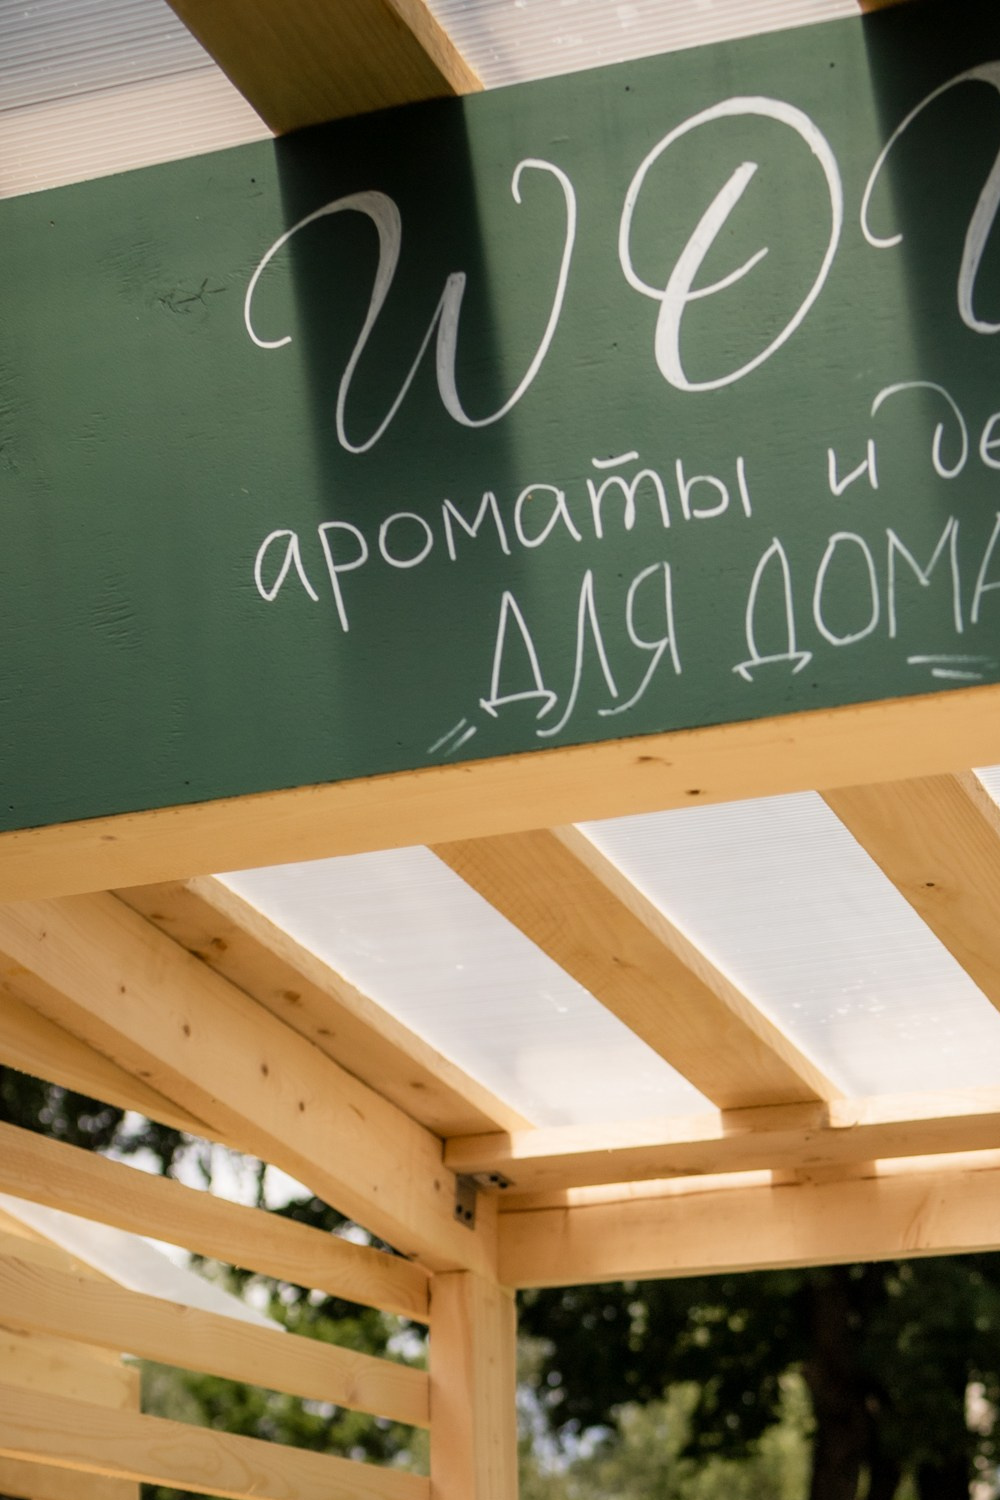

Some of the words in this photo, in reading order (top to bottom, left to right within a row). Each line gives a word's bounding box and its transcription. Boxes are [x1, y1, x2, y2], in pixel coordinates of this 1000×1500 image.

[254, 451, 751, 632] ароматы
[826, 439, 878, 497] и
[480, 561, 682, 738] ДЛЯ
